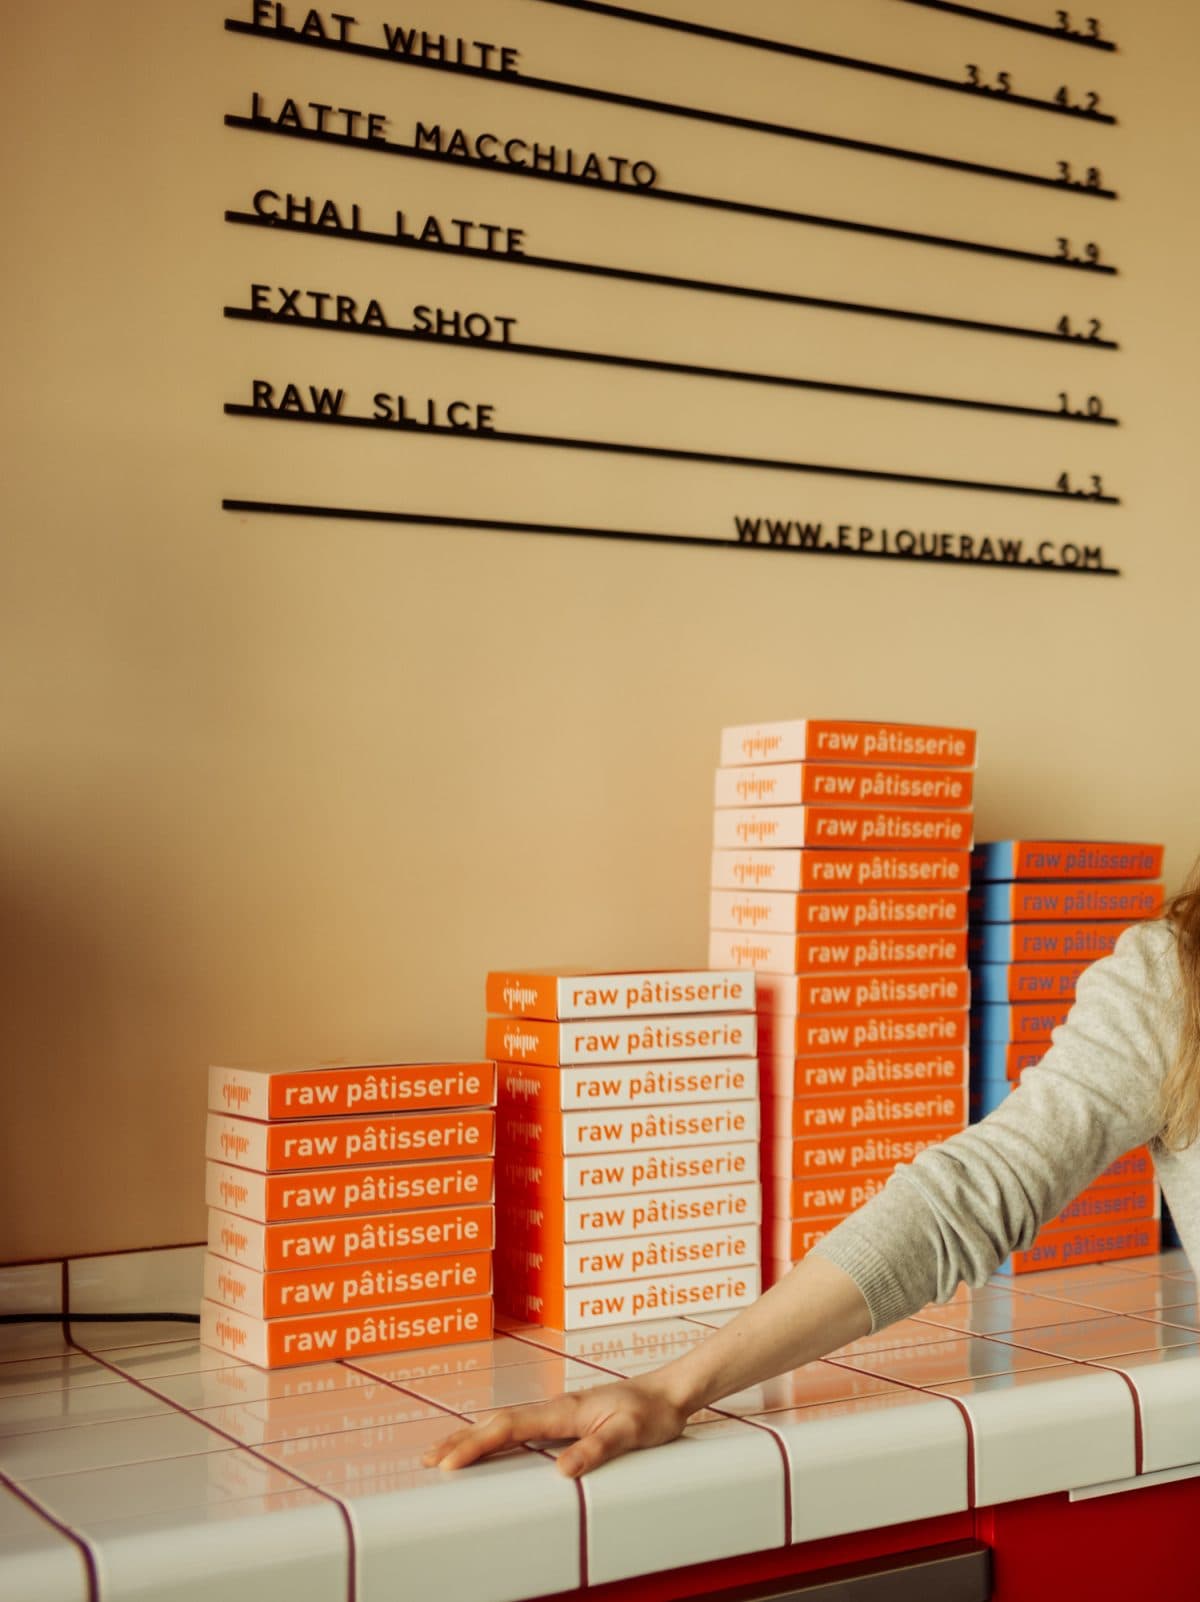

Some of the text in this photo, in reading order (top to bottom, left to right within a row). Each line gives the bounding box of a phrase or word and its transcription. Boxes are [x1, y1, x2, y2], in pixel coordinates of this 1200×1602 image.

[1055, 10, 1099, 39] 3.3
[252, 0, 1099, 114] FLAT WHITE 3.5 4.2
[252, 92, 1100, 190] LATTE MACCHIATO 3.8
[252, 189, 1099, 265] CHAI LATTE 3.9
[251, 284, 1101, 344] EXTRA SHOT 4.2
[252, 380, 1102, 432] RAW SLICE 1.0
[1056, 472, 1102, 497] 4.3
[734, 515, 1102, 568] WWW.EPIQUERAW.COM
[817, 729, 966, 756] raw pâtisserie
[814, 772, 962, 798] raw pâtisserie
[816, 815, 962, 841] raw pâtisserie
[812, 861, 854, 880] raw
[859, 857, 959, 885] pâtisserie
[808, 903, 849, 922] raw
[854, 899, 956, 926] pâtisserie
[808, 945, 849, 964] raw
[854, 939, 956, 967] pâtisserie
[1063, 930, 1116, 955] pâtiss
[573, 979, 743, 1009] raw pâtisserie
[810, 985, 851, 1005] raw
[856, 977, 958, 1007] pâtisserie
[1018, 974, 1053, 991] raw
[574, 1025, 743, 1054] raw pâtisserie
[807, 1026, 848, 1046] raw
[853, 1017, 957, 1047] pâtisserie
[576, 1068, 745, 1100] raw pâtisserie
[805, 1066, 846, 1086] raw
[852, 1057, 956, 1087] pâtisserie
[285, 1072, 480, 1108] raw pâtisserie
[577, 1111, 746, 1144] raw pâtisserie
[804, 1106, 846, 1127] raw
[851, 1096, 955, 1128] pâtisserie
[284, 1122, 480, 1159] raw pâtisserie
[803, 1133, 944, 1168] raw pâtisse
[579, 1153, 746, 1187] raw pâtisserie
[282, 1170, 479, 1209] raw pâtisserie
[803, 1188, 845, 1208] raw
[580, 1194, 747, 1230] raw pâtisserie
[282, 1217, 479, 1258] raw pâtisserie
[579, 1236, 747, 1274] raw pâtisserie
[280, 1263, 477, 1305] raw pâtisserie
[580, 1278, 747, 1318] raw pâtisserie
[284, 1309, 479, 1353] raw pâtisserie
